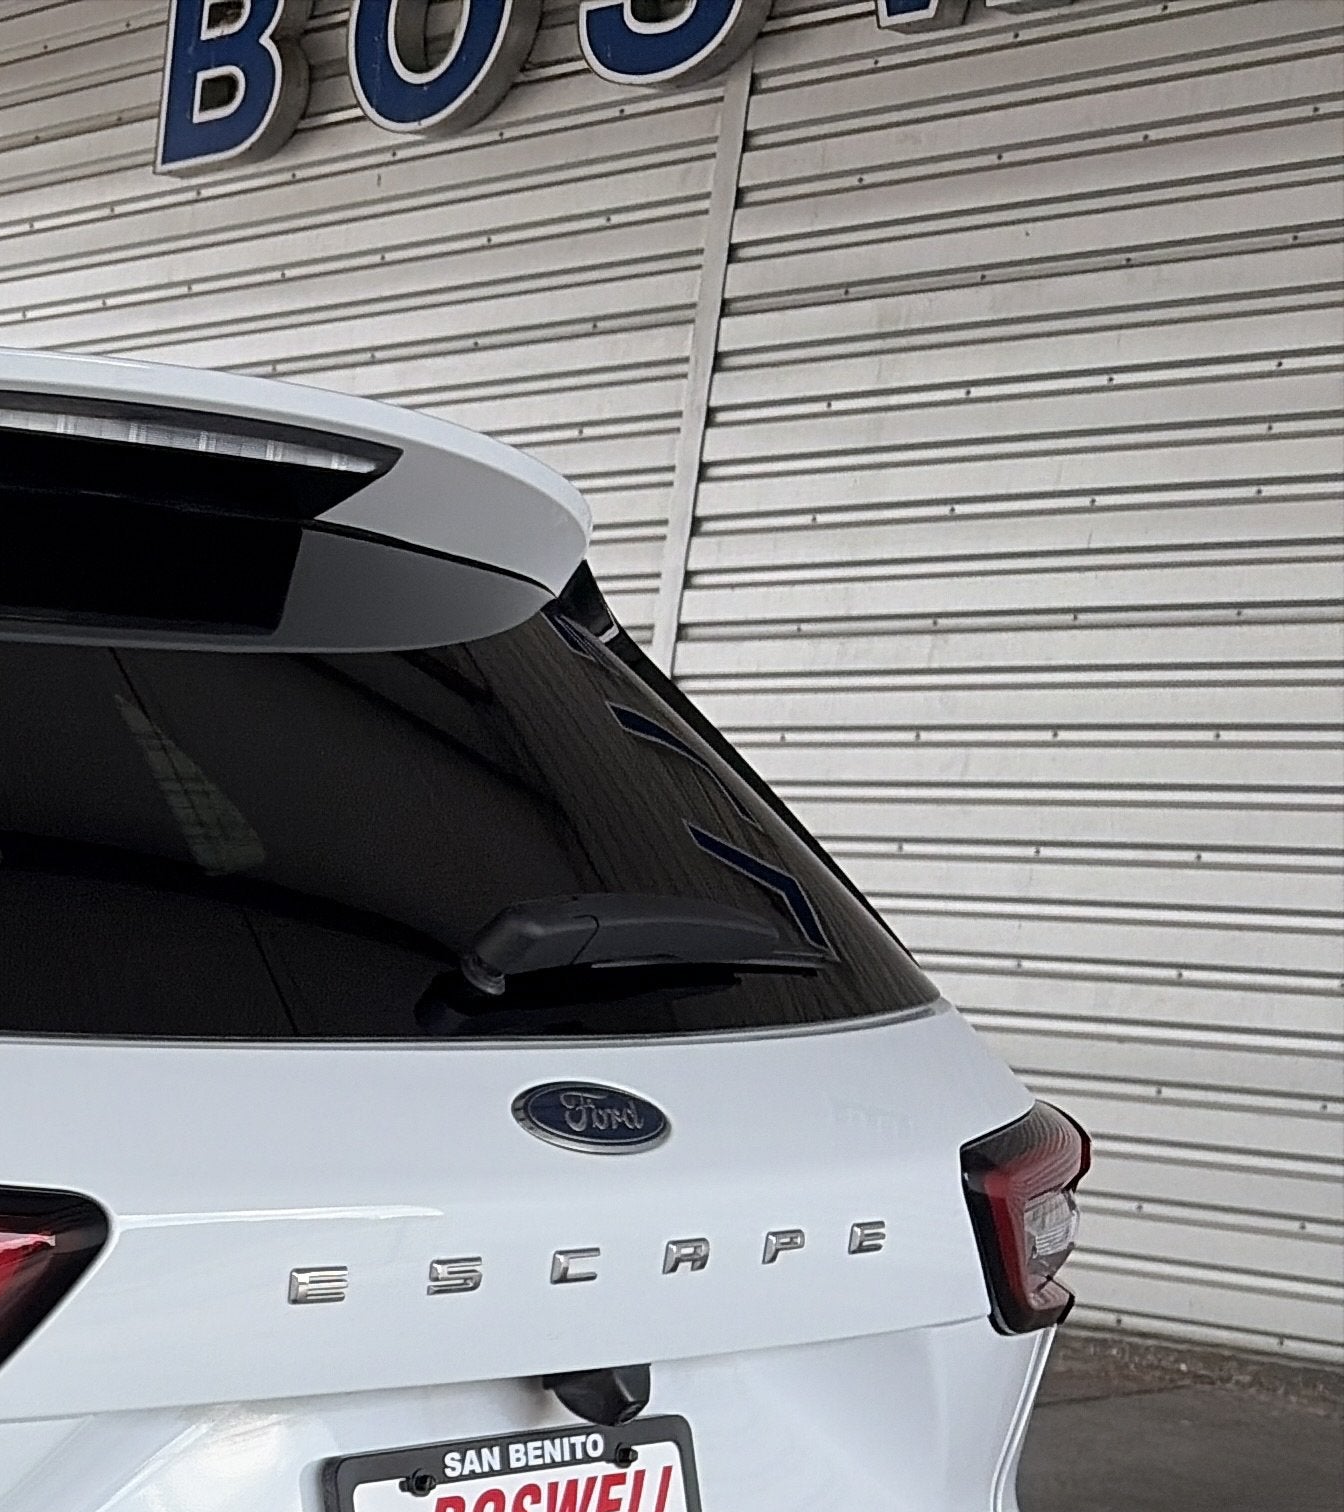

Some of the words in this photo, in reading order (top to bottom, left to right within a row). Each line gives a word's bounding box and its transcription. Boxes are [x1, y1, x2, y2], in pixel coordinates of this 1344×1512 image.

[287, 1220, 887, 1306] ESCAPE
[444, 1446, 500, 1478] SAN
[509, 1433, 605, 1469] BENITO
